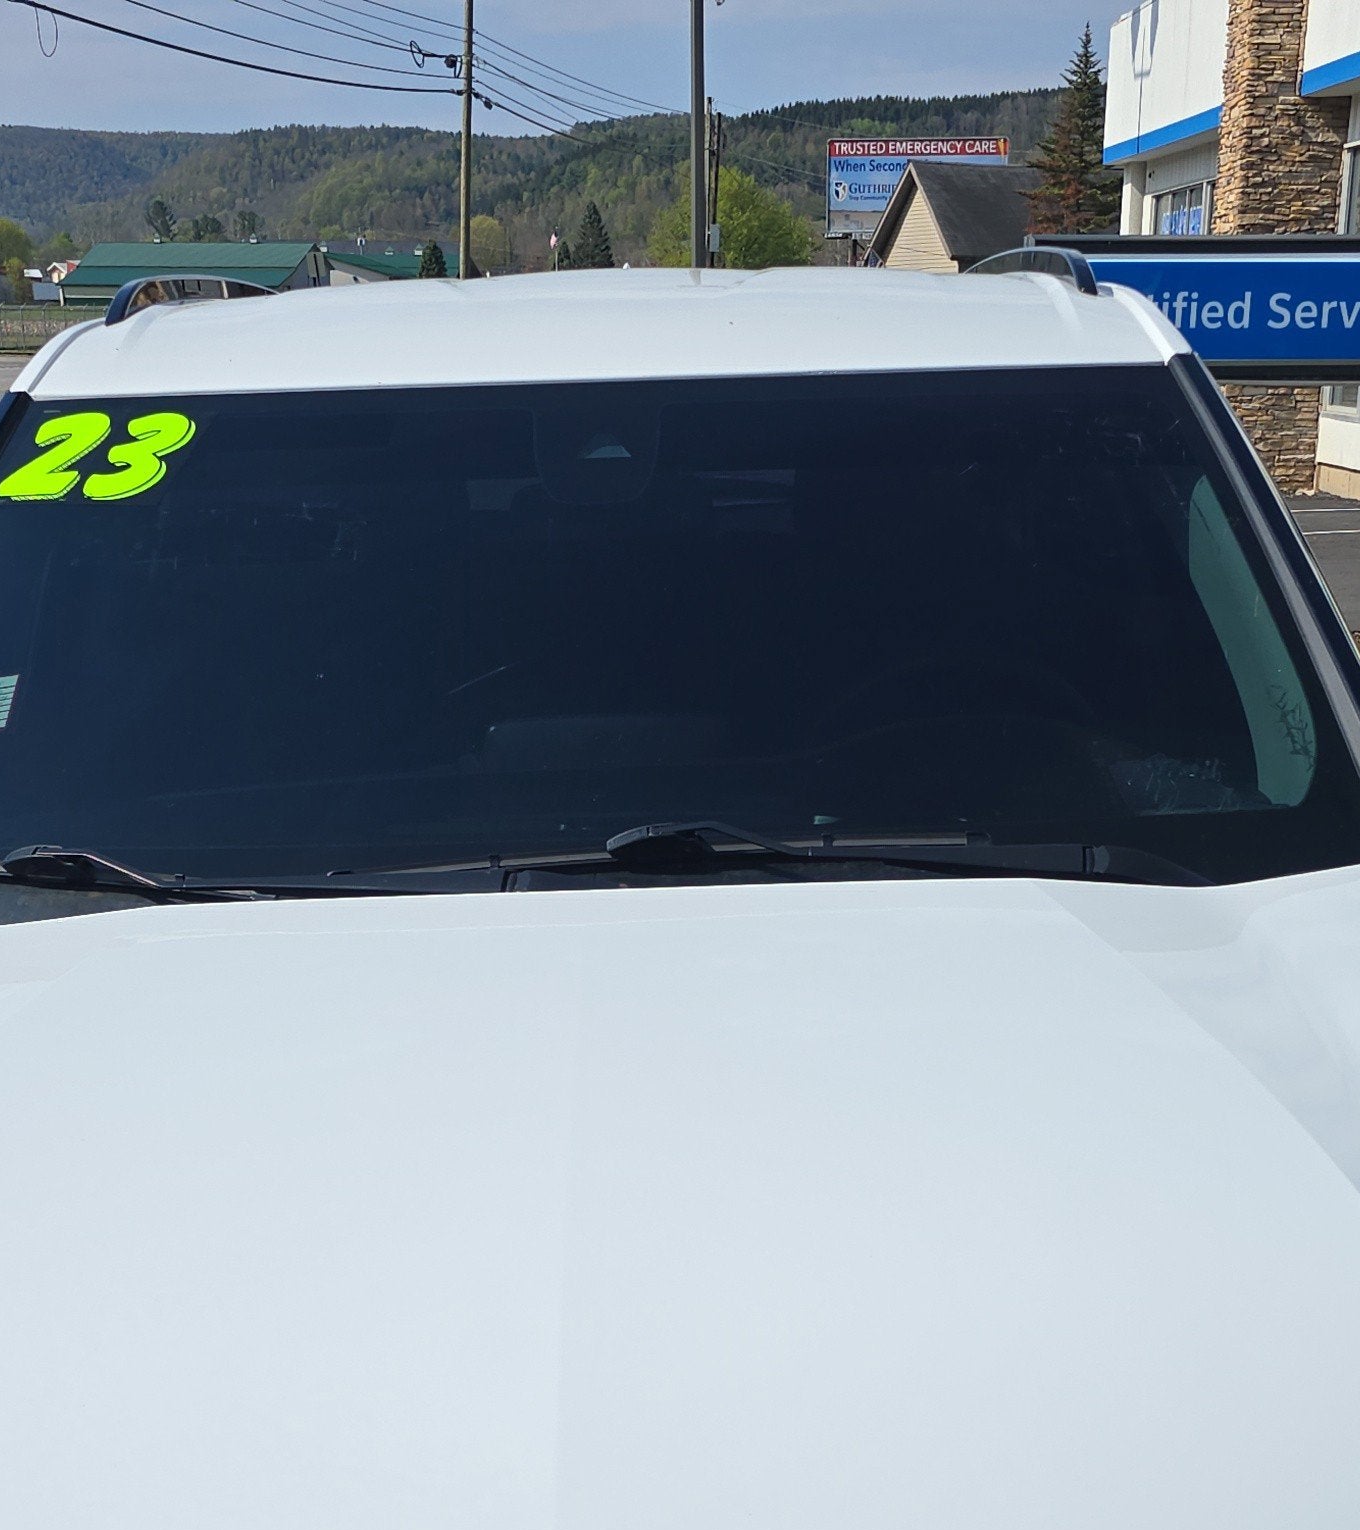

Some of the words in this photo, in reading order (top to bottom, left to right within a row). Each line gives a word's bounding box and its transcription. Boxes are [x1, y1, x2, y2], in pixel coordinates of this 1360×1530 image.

[834, 142, 886, 155] TRUSTED
[889, 141, 961, 155] EMERGENCY
[965, 141, 997, 153] CARE
[834, 160, 866, 172] When
[1147, 291, 1252, 329] ified
